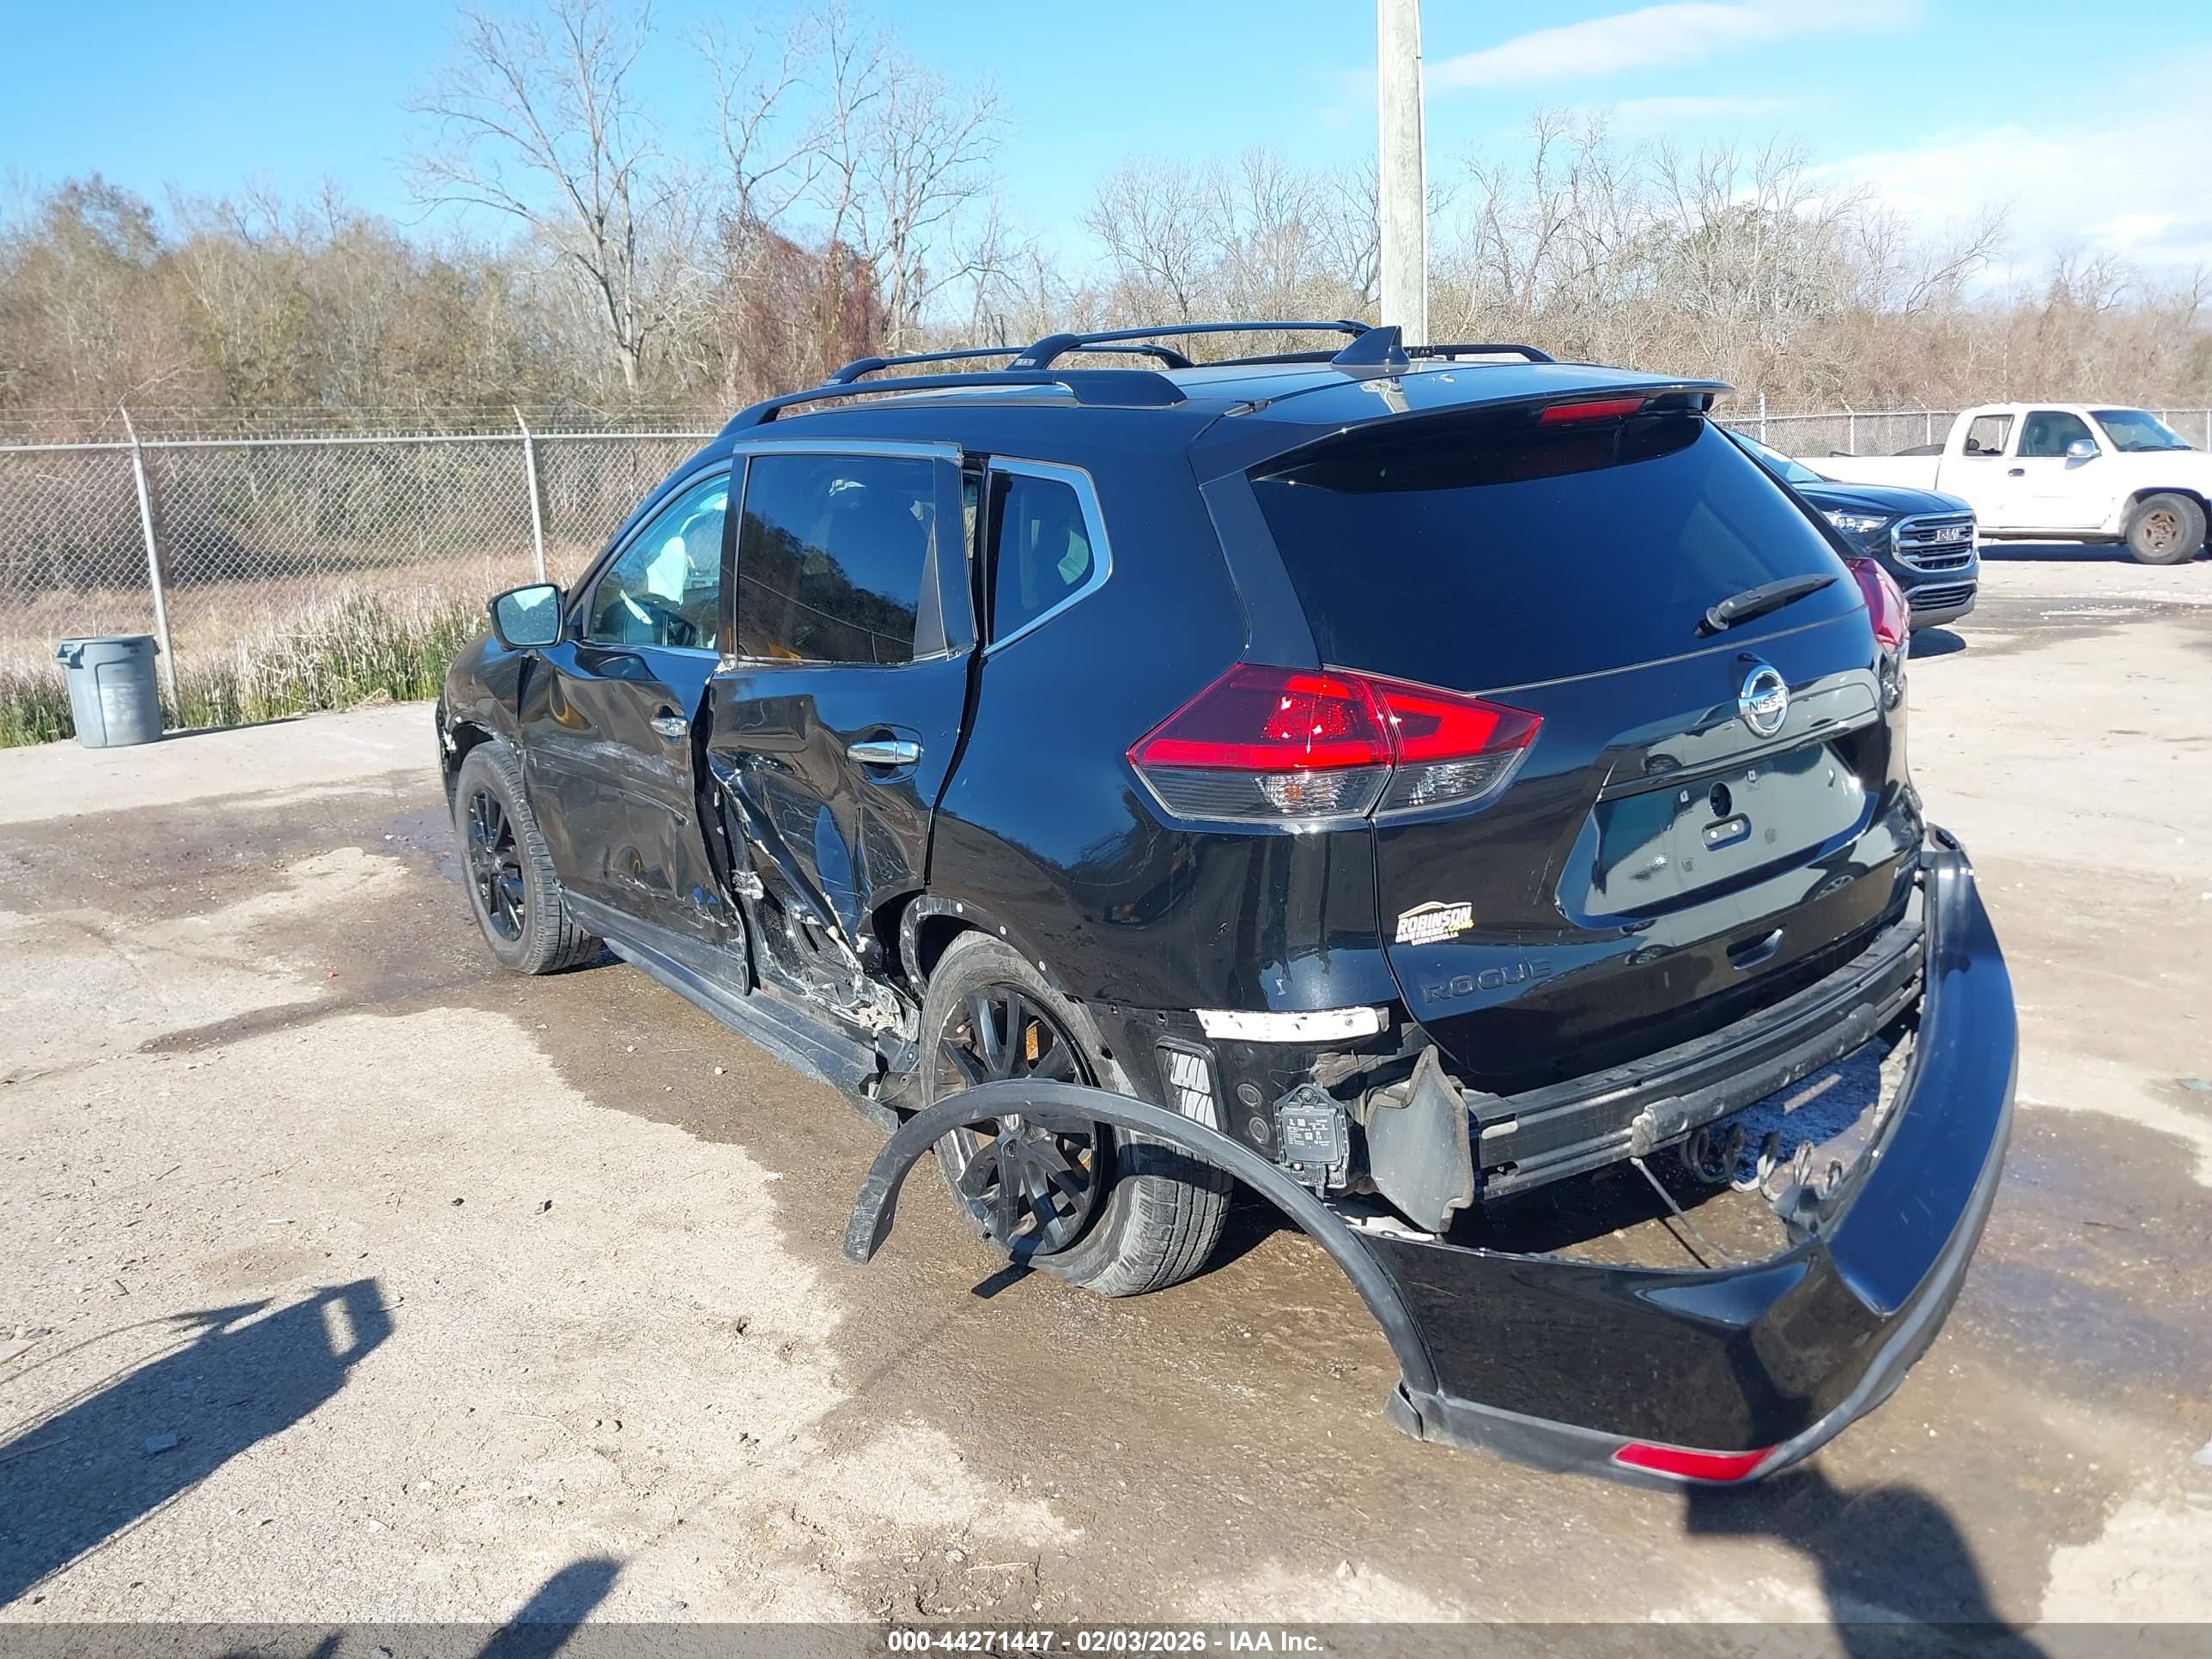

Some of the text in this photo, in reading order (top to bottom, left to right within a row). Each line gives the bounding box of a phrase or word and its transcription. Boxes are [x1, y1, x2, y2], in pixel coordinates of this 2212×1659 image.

[1936, 526, 1966, 542] GMC
[1396, 906, 1472, 935] ROBINSON
[1421, 958, 1553, 1004] ROGUE
